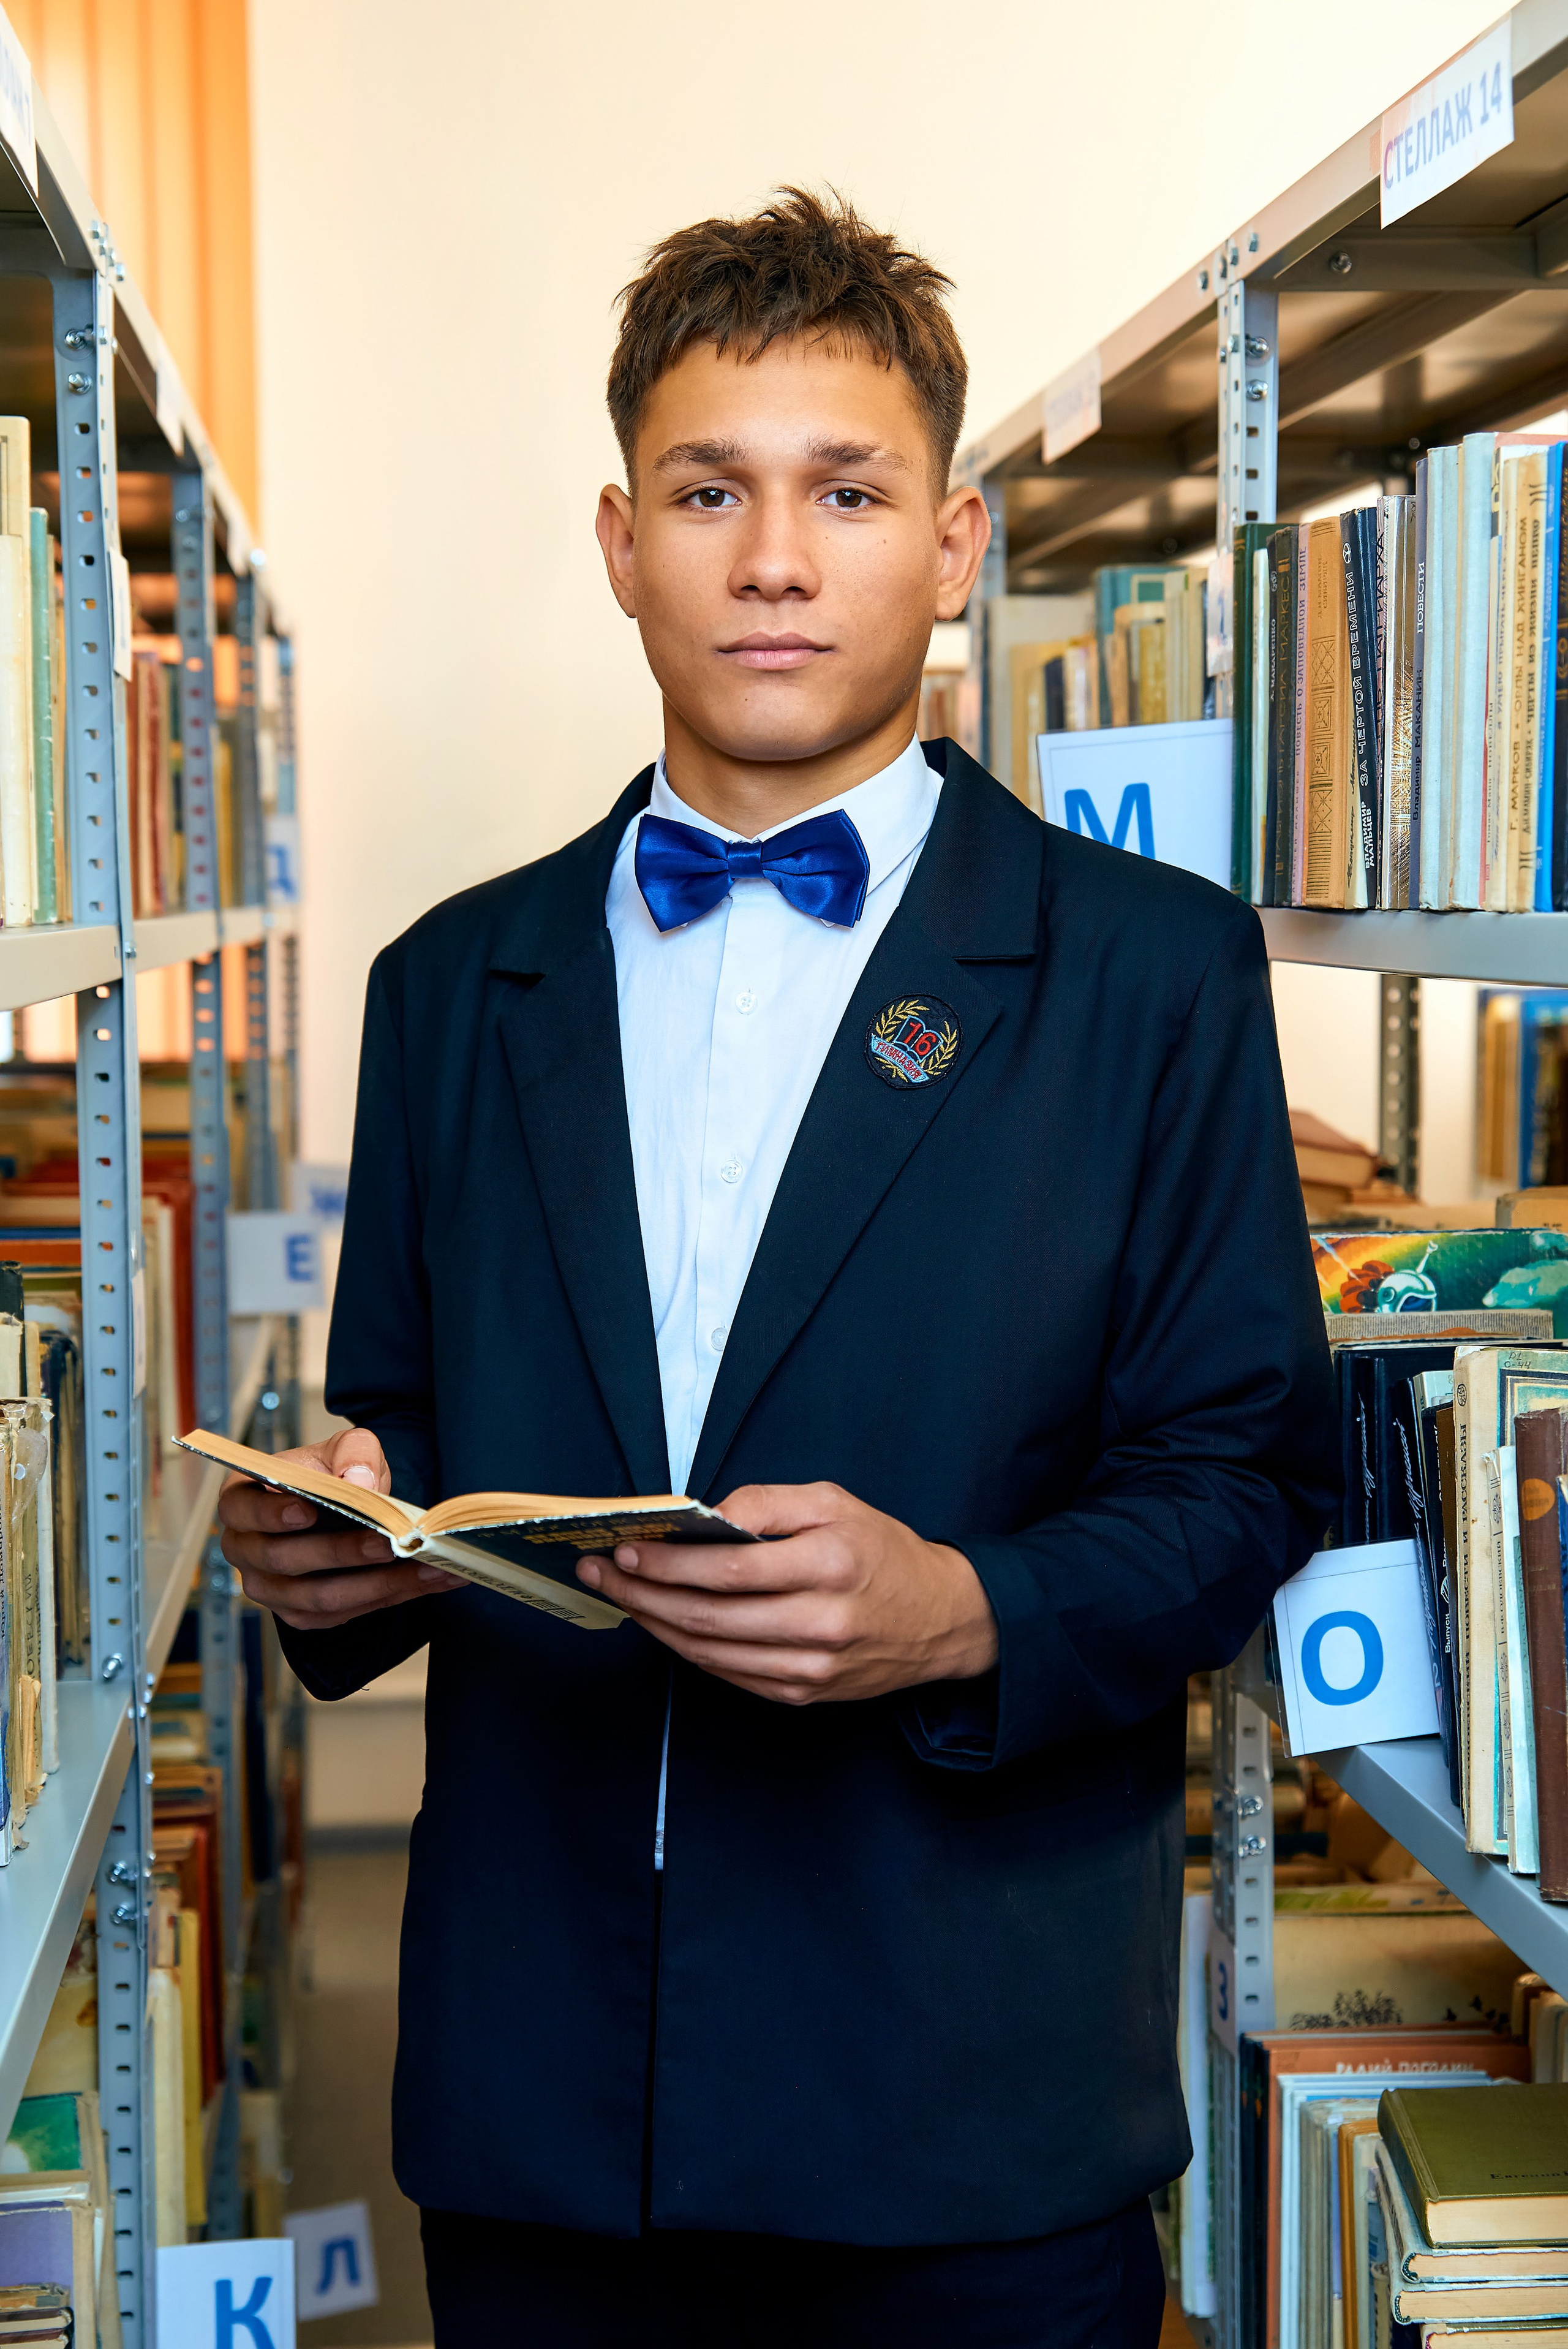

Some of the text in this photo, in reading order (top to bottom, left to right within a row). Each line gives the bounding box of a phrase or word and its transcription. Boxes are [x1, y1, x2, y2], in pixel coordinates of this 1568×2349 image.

[1384, 60, 1502, 189] СТЕЛЛАЖ 14
[1518, 516, 1528, 613] ХИНГАНОМ
[1278, 576, 1290, 660] МАРКЕС
[1528, 578, 1538, 637] ЖИЗНИ
[1517, 623, 1525, 657] НАД
[1528, 644, 1536, 664] ИЗ
[1297, 688, 1303, 697] О
[1346, 572, 1368, 787] ЗА ЧЕРТОЙ ВРЕМЕНИ
[1514, 667, 1523, 713] ОРЛЫ
[1526, 672, 1535, 724] ЧЕРТЫ
[1512, 741, 1521, 811] МАРКОВ
[1065, 782, 1156, 860] М
[1360, 801, 1370, 869] ВЛАДИМИР
[1366, 808, 1375, 867] МАЛЬЦЕВ
[875, 1041, 923, 1080] ГИМНАЗИЯ
[903, 1021, 937, 1056] 16
[284, 1233, 315, 1282] Е
[1460, 1423, 1468, 1522] РАССКАЗЫ
[1462, 1531, 1468, 1545] И
[1301, 1611, 1384, 1706] О
[315, 2236, 361, 2296] Л
[214, 2277, 276, 2349] К
